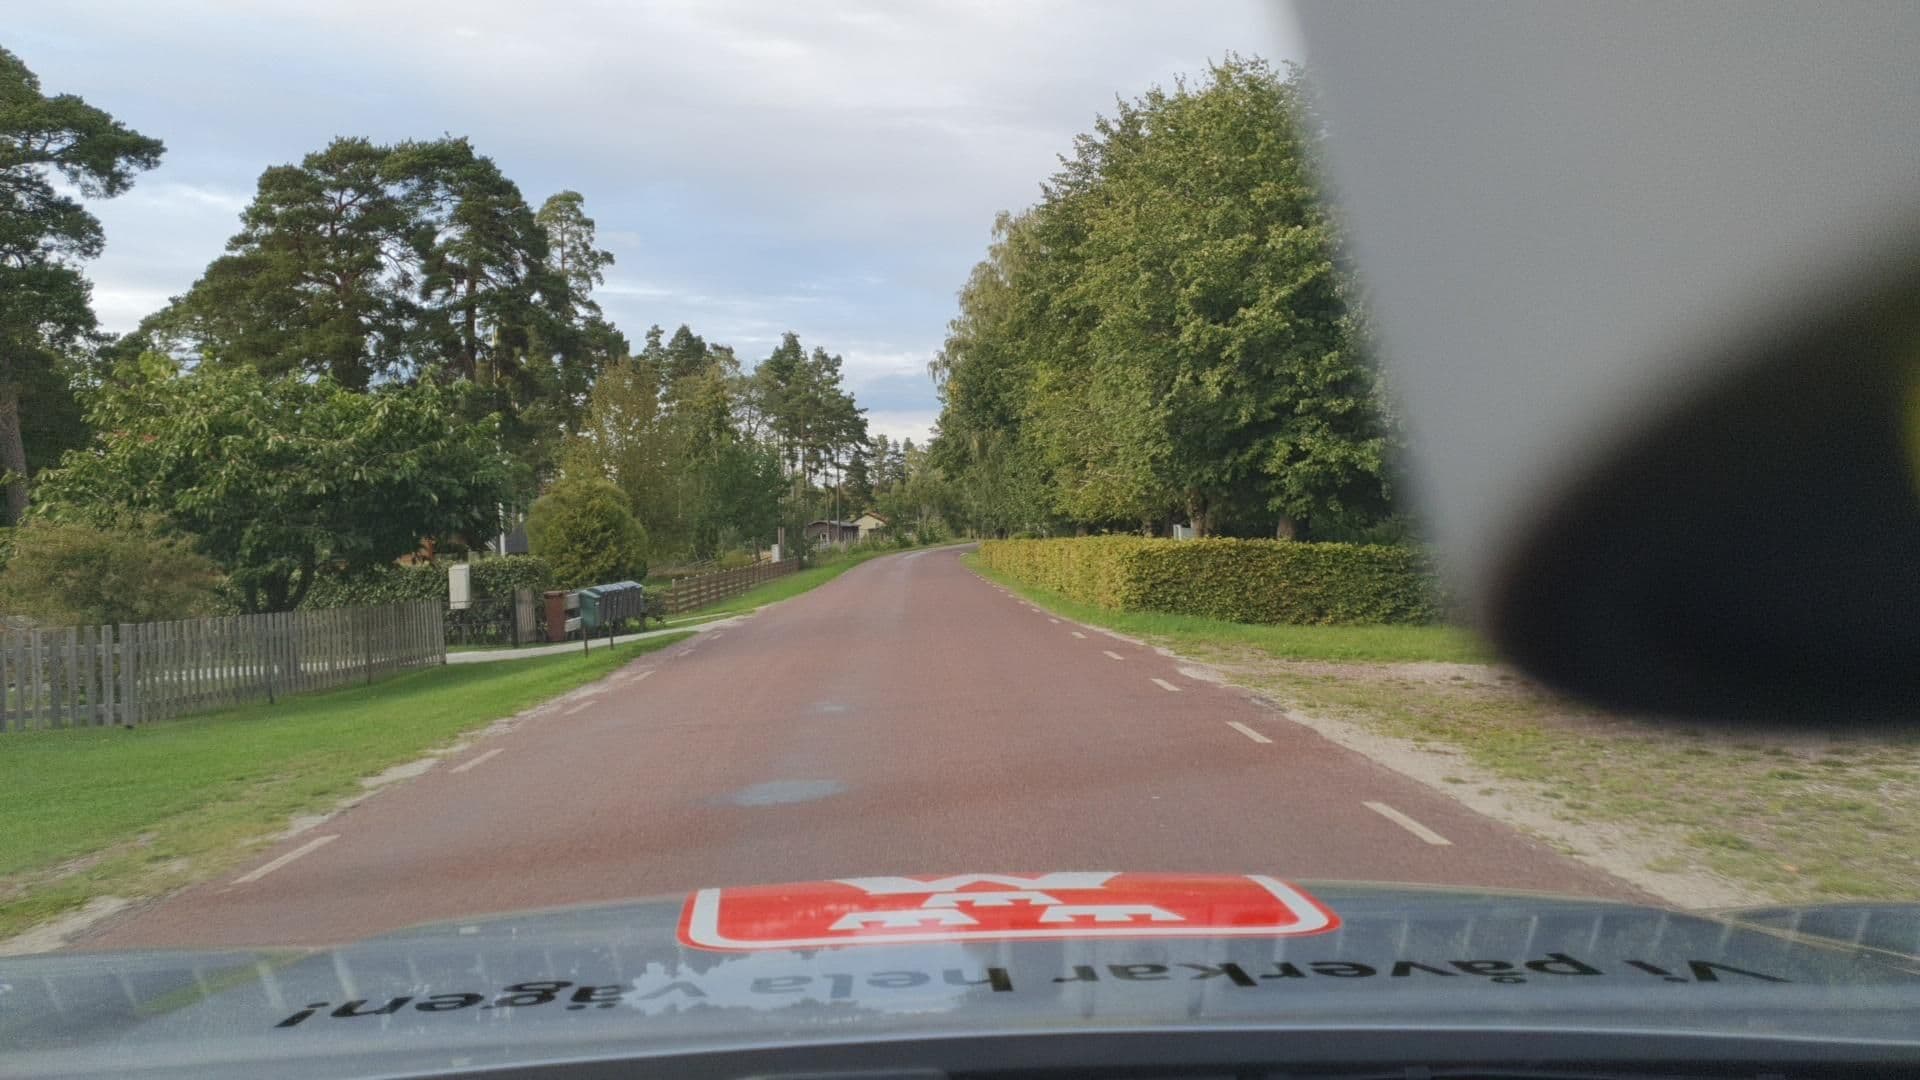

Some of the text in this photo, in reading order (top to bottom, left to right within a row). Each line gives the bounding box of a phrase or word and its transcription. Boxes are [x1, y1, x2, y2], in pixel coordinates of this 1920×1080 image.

[273, 953, 1794, 1028] Vi påverkar hela vägen!
